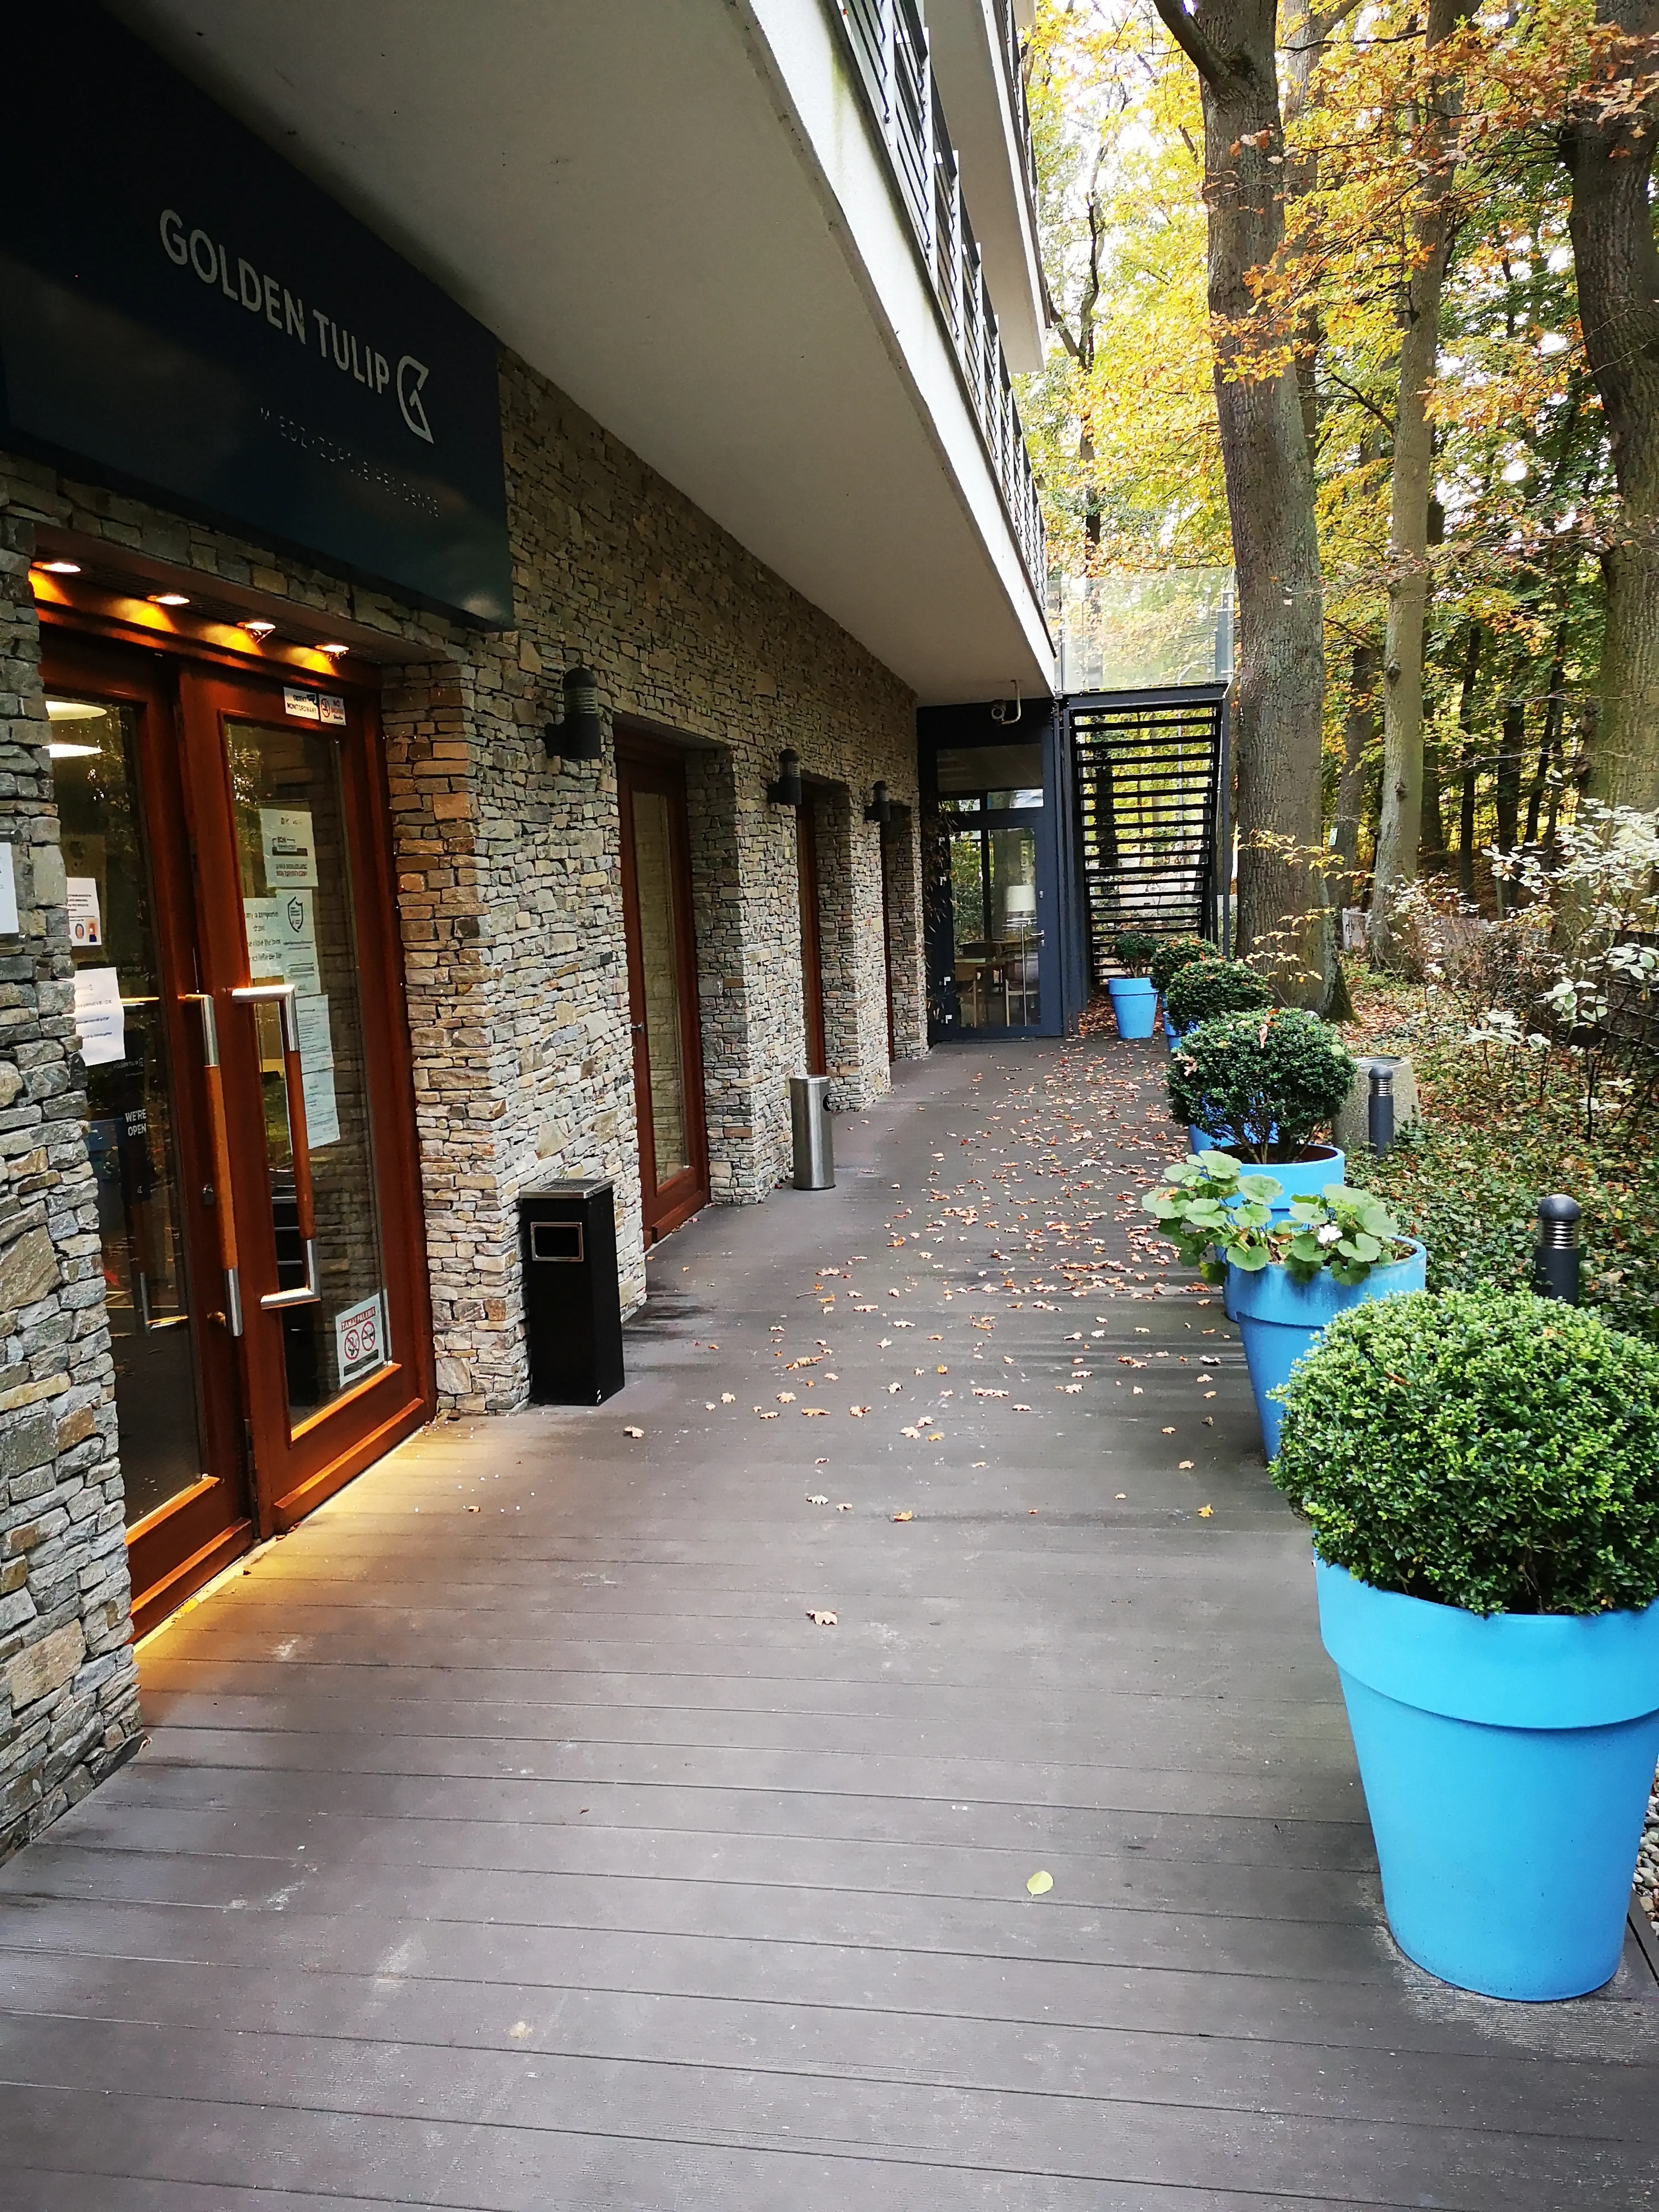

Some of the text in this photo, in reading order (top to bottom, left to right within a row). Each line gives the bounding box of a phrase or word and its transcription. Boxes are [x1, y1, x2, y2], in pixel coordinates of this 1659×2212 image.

[159, 209, 306, 345] GOLDEN
[312, 308, 390, 394] TULIP
[125, 1109, 147, 1122] WE'RE
[127, 1123, 147, 1137] OPEN
